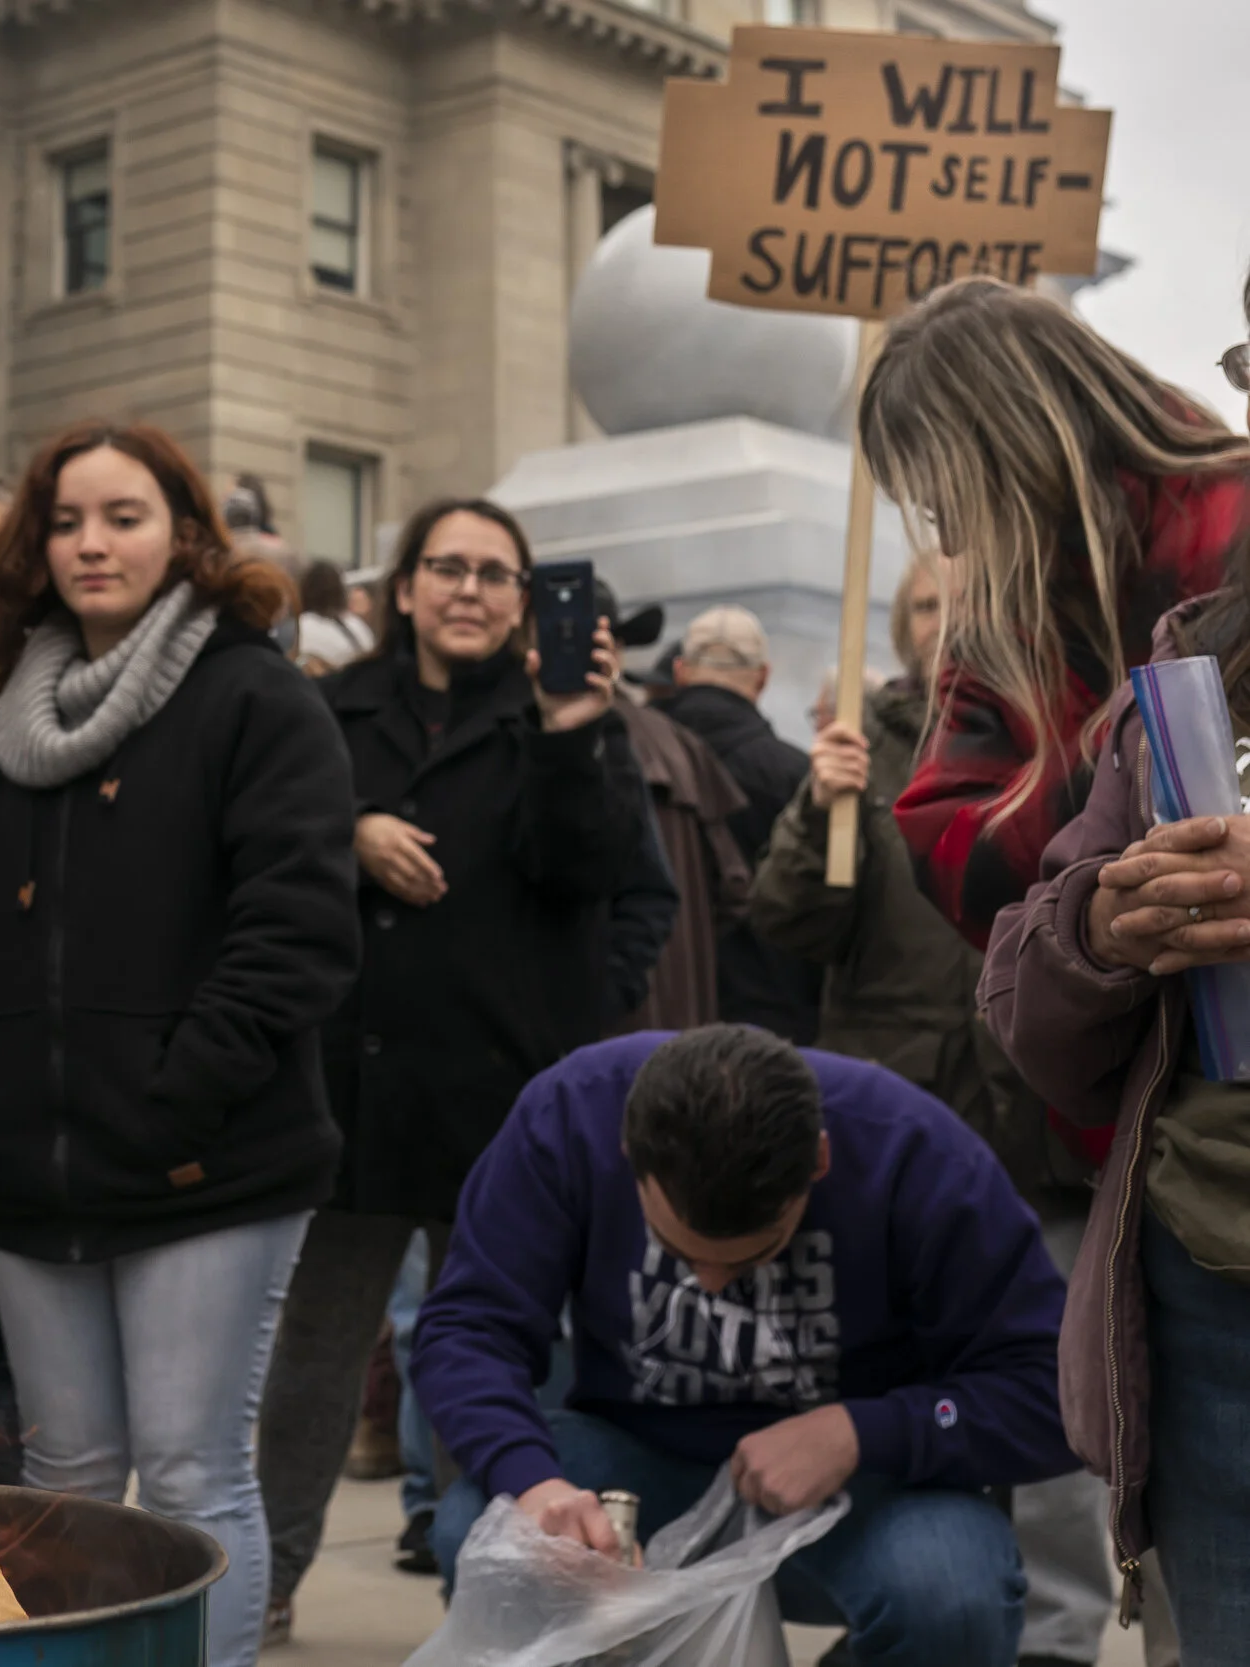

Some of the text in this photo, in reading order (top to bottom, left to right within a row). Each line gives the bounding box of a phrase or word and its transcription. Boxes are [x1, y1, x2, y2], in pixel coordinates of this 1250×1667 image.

[758, 58, 1049, 133] I WILL
[773, 131, 1092, 211] NOT SELF-
